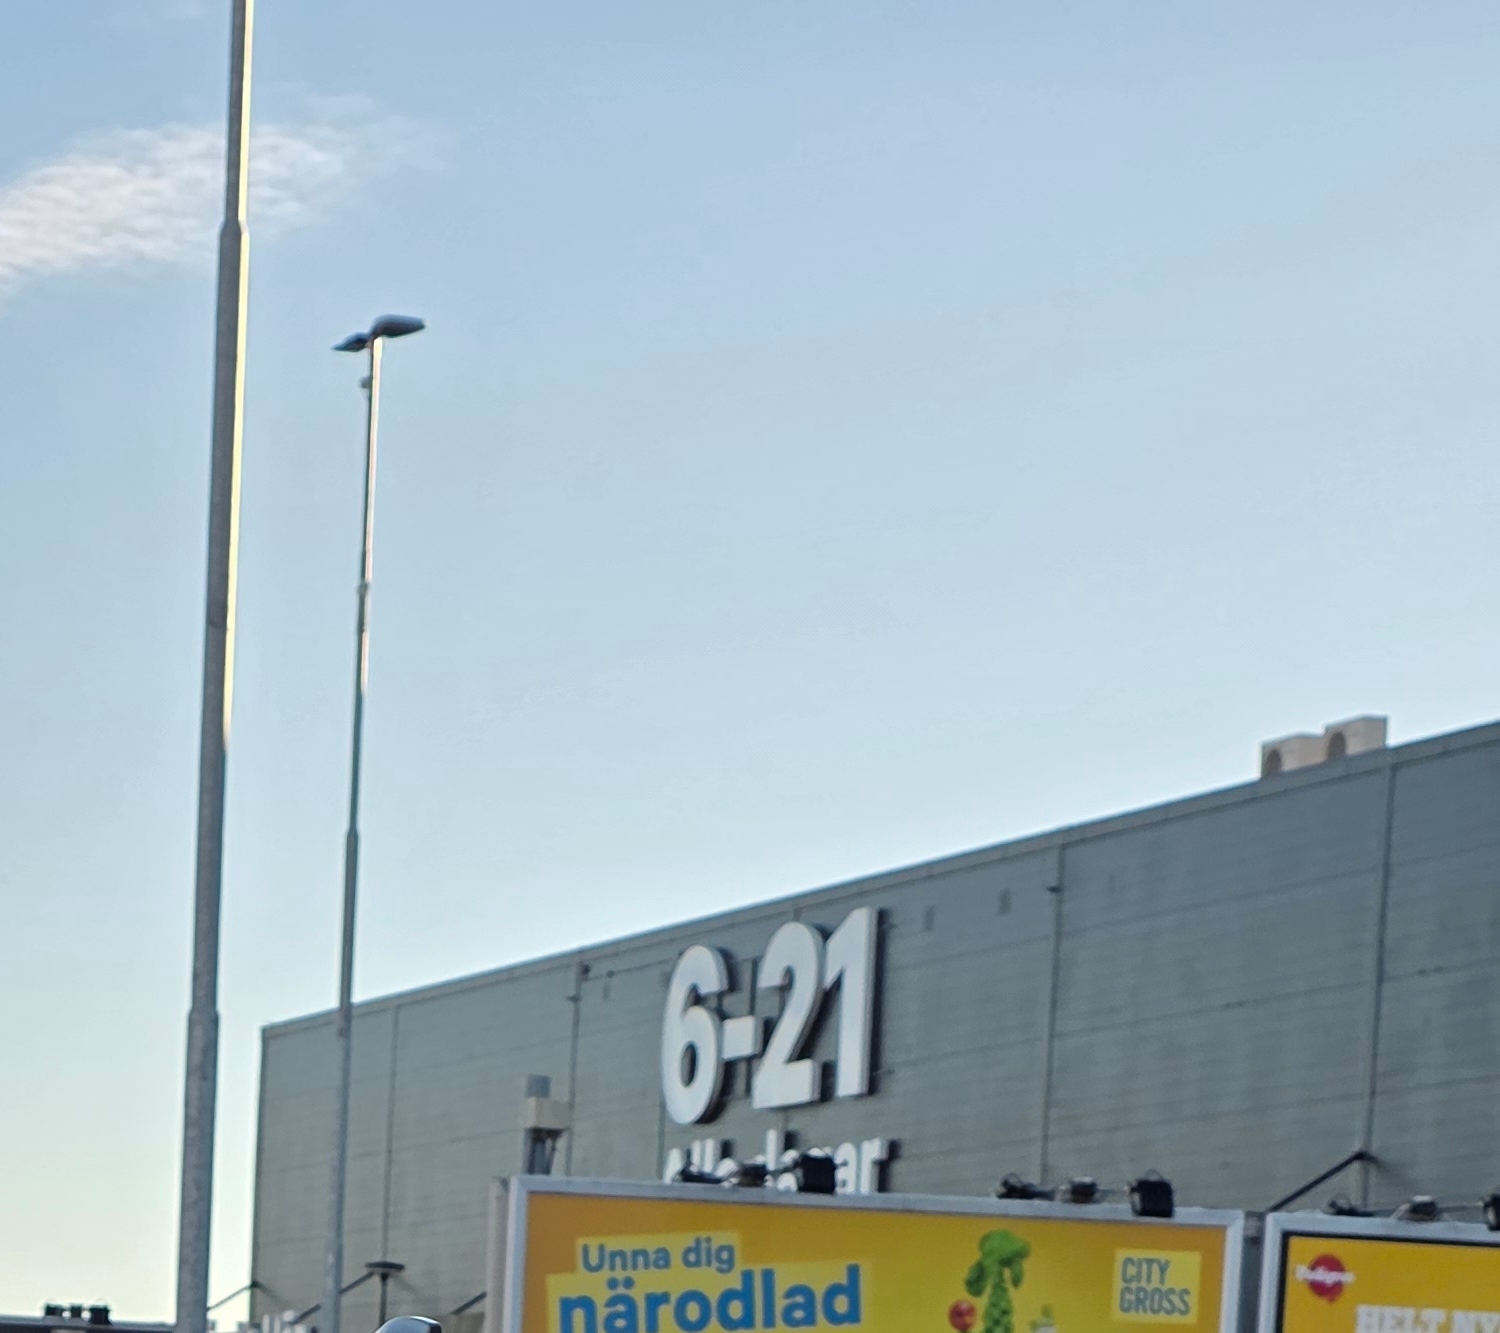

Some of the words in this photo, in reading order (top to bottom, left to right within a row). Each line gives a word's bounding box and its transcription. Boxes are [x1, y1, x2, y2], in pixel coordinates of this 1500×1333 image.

[661, 906, 876, 1125] 6-21
[582, 1243, 671, 1273] Unna
[681, 1236, 735, 1274] dig
[1121, 1256, 1171, 1286] CITY
[1119, 1285, 1191, 1316] GROSS
